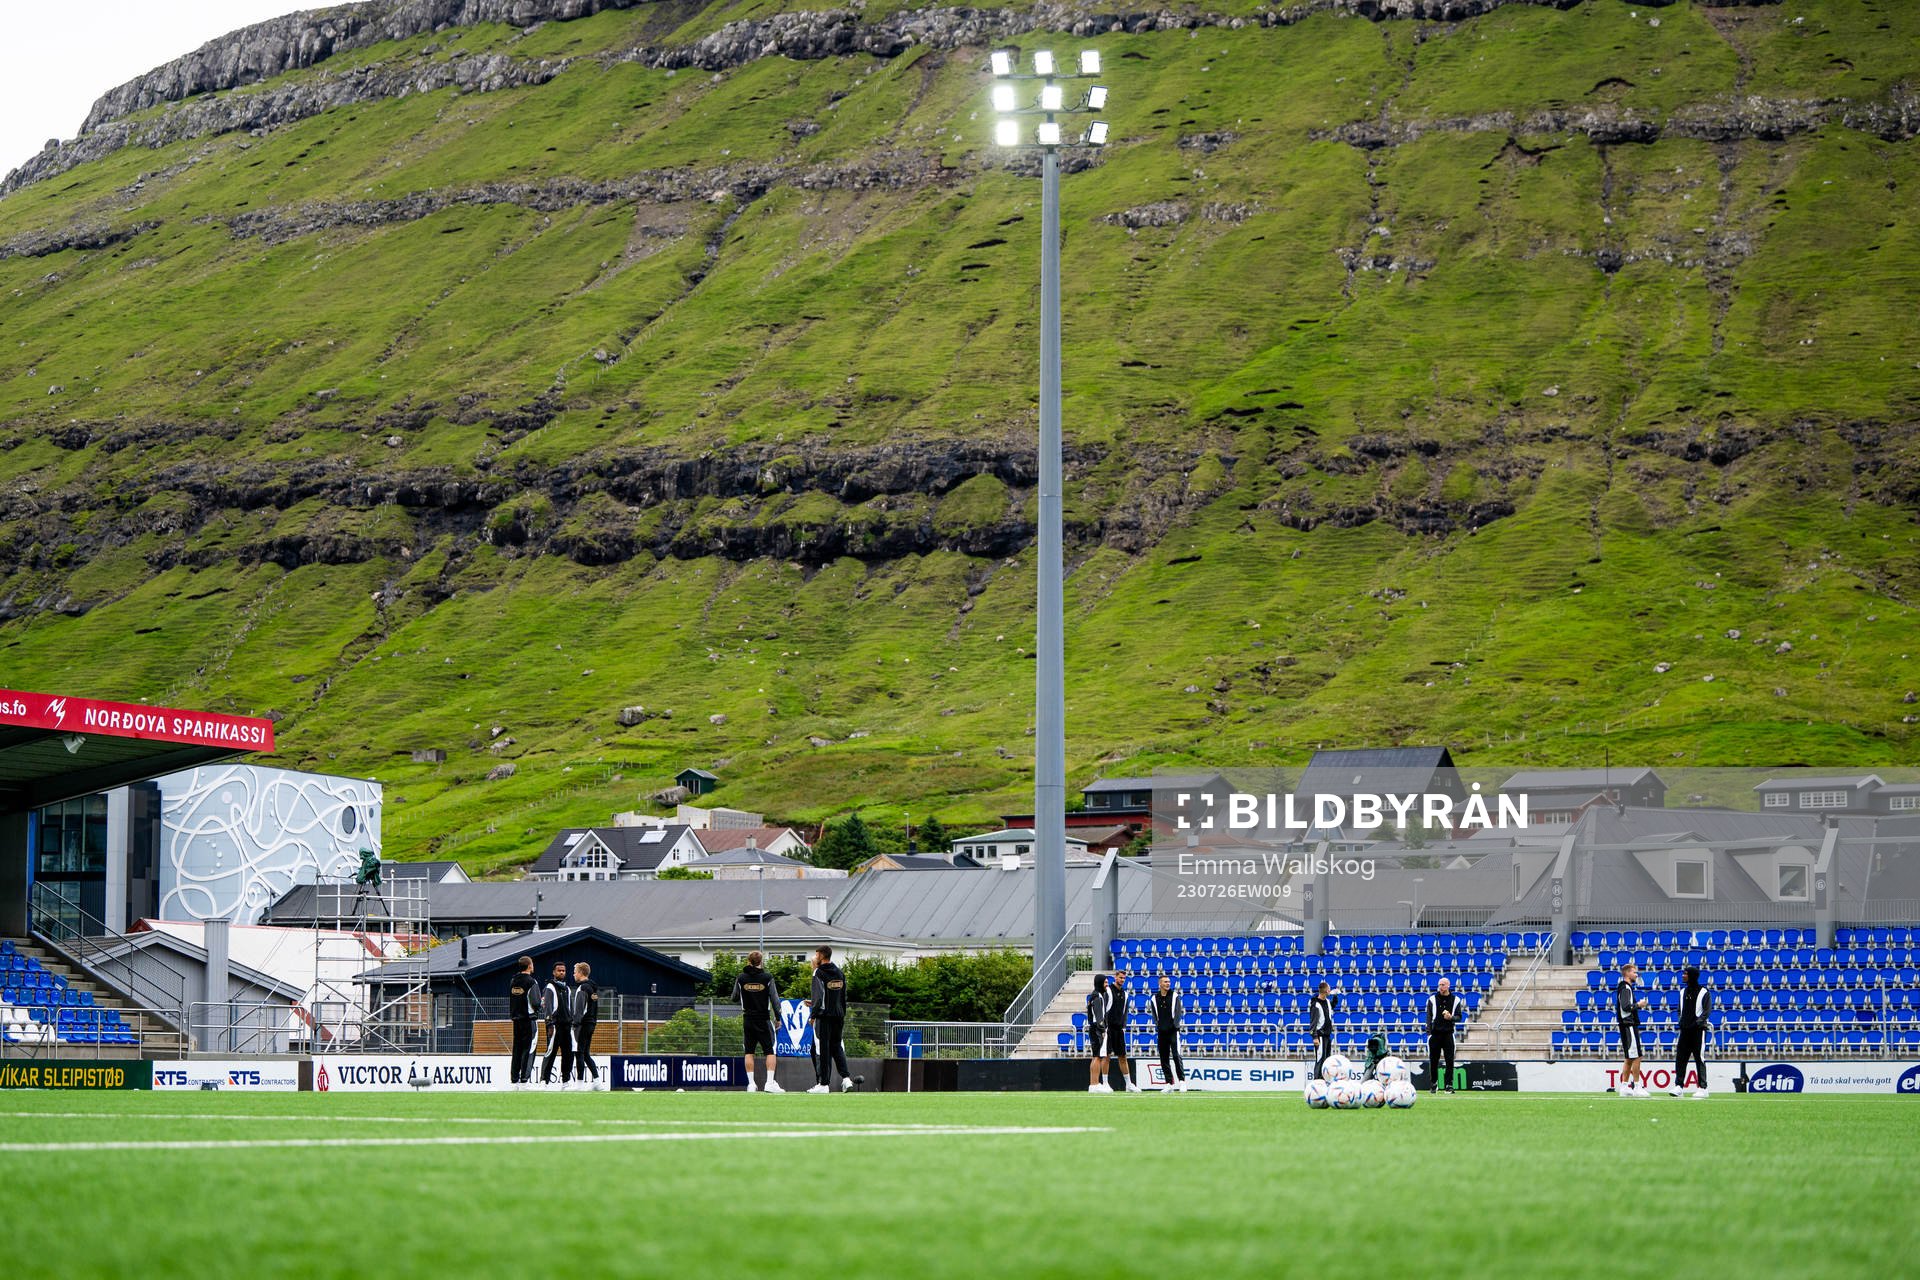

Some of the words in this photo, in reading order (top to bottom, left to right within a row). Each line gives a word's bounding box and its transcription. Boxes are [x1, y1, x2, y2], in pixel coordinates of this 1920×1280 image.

[0, 699, 27, 716] s.fo
[173, 719, 266, 744] SPARIKASSI
[44, 1067, 124, 1088] SLEIPISTØÐ
[155, 1071, 187, 1085] RTS
[229, 1071, 260, 1085] RTS
[338, 1066, 402, 1084] VICTOR
[408, 1061, 417, 1084] Á
[623, 1060, 668, 1082] formula
[682, 1060, 728, 1082] formula
[1183, 1069, 1242, 1081] FAROE
[1250, 1070, 1295, 1082] SHIP
[1606, 1069, 1700, 1088] TYOA
[1875, 1077, 1892, 1086] gott
